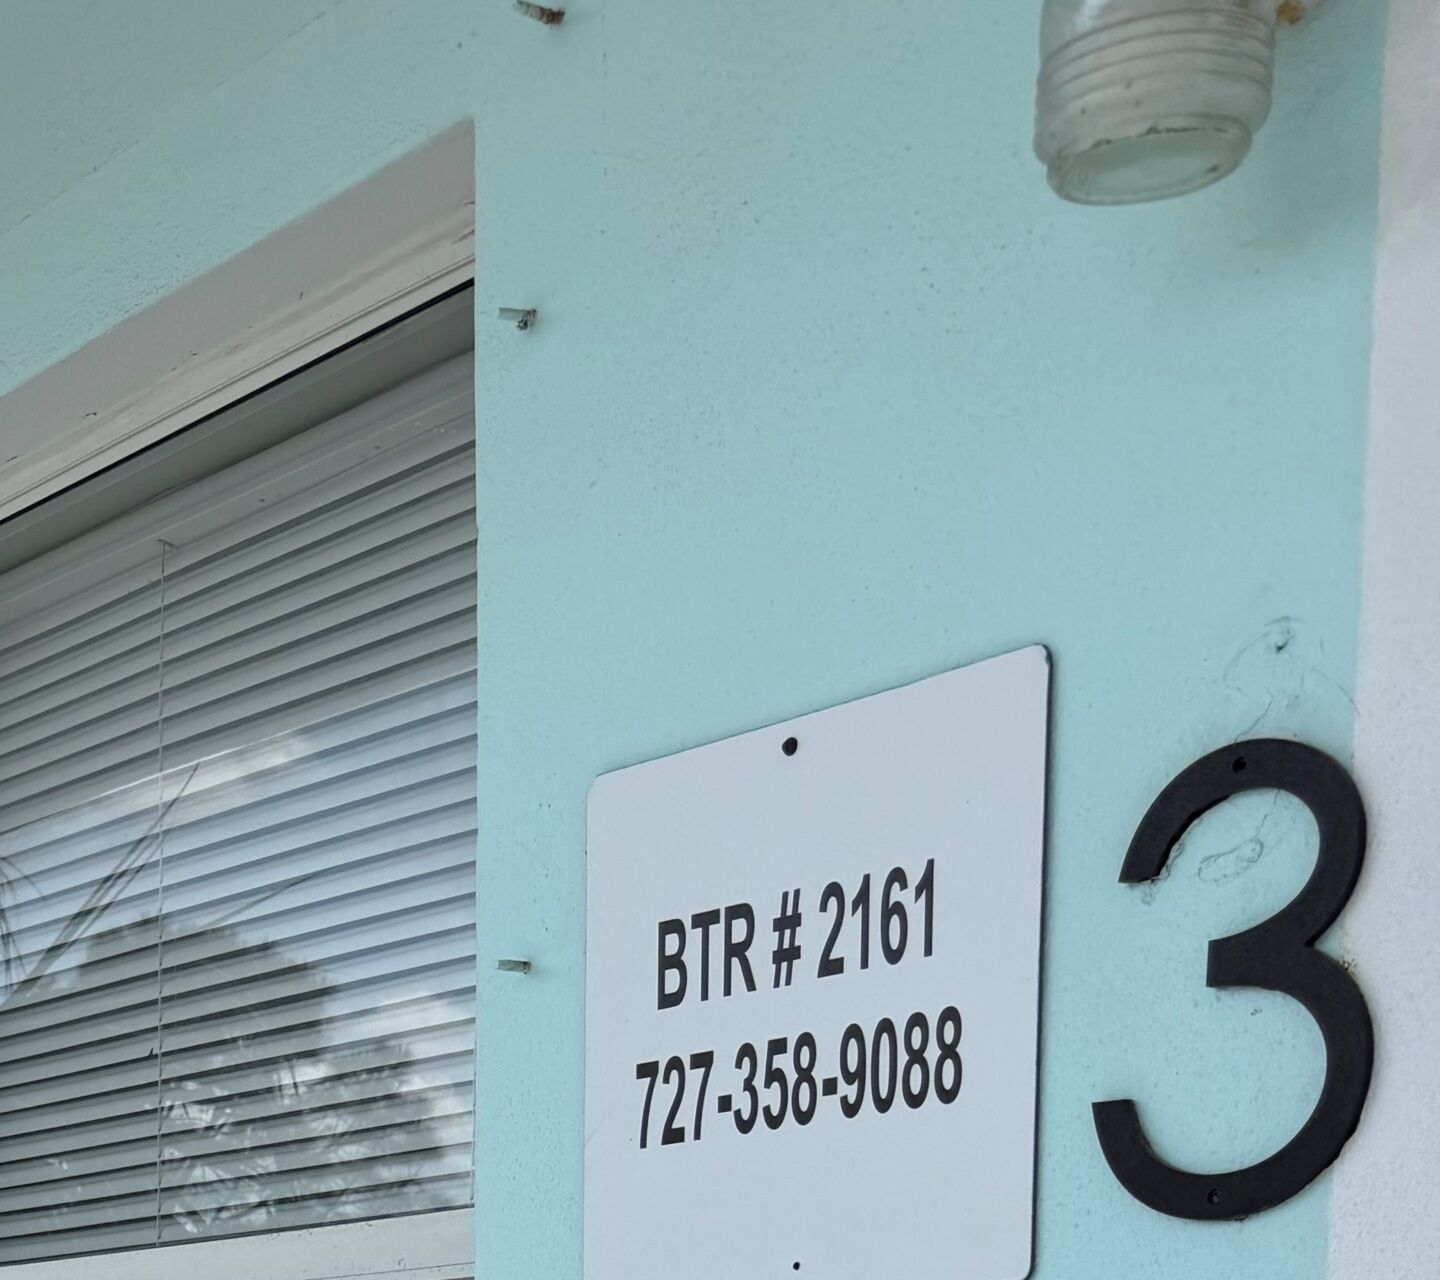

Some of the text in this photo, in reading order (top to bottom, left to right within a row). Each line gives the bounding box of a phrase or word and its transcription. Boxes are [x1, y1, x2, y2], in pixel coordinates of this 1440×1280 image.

[656, 857, 936, 1010] BTR # 2161
[1092, 738, 1374, 1221] 3
[635, 1005, 963, 1150] 727-358-9088
